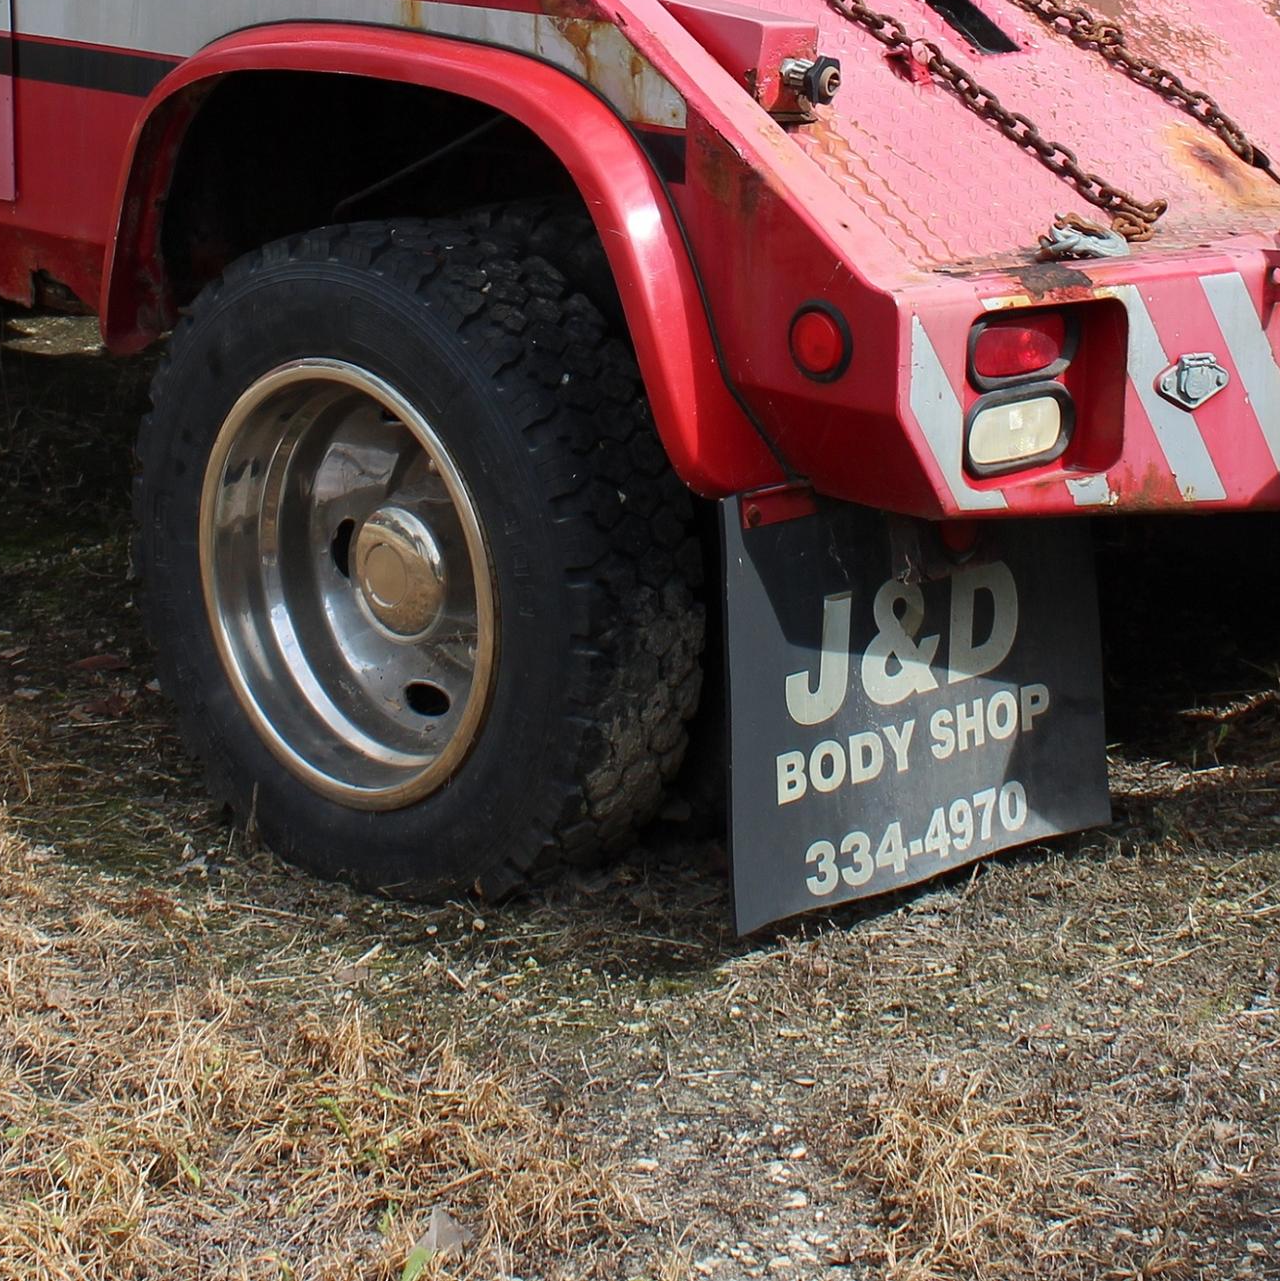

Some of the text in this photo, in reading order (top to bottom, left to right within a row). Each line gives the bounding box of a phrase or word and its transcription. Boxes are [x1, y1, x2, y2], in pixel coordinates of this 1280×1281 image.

[785, 560, 1019, 726] J&D
[776, 683, 1051, 806] BODY SHOP
[805, 781, 1028, 896] 334-4970
